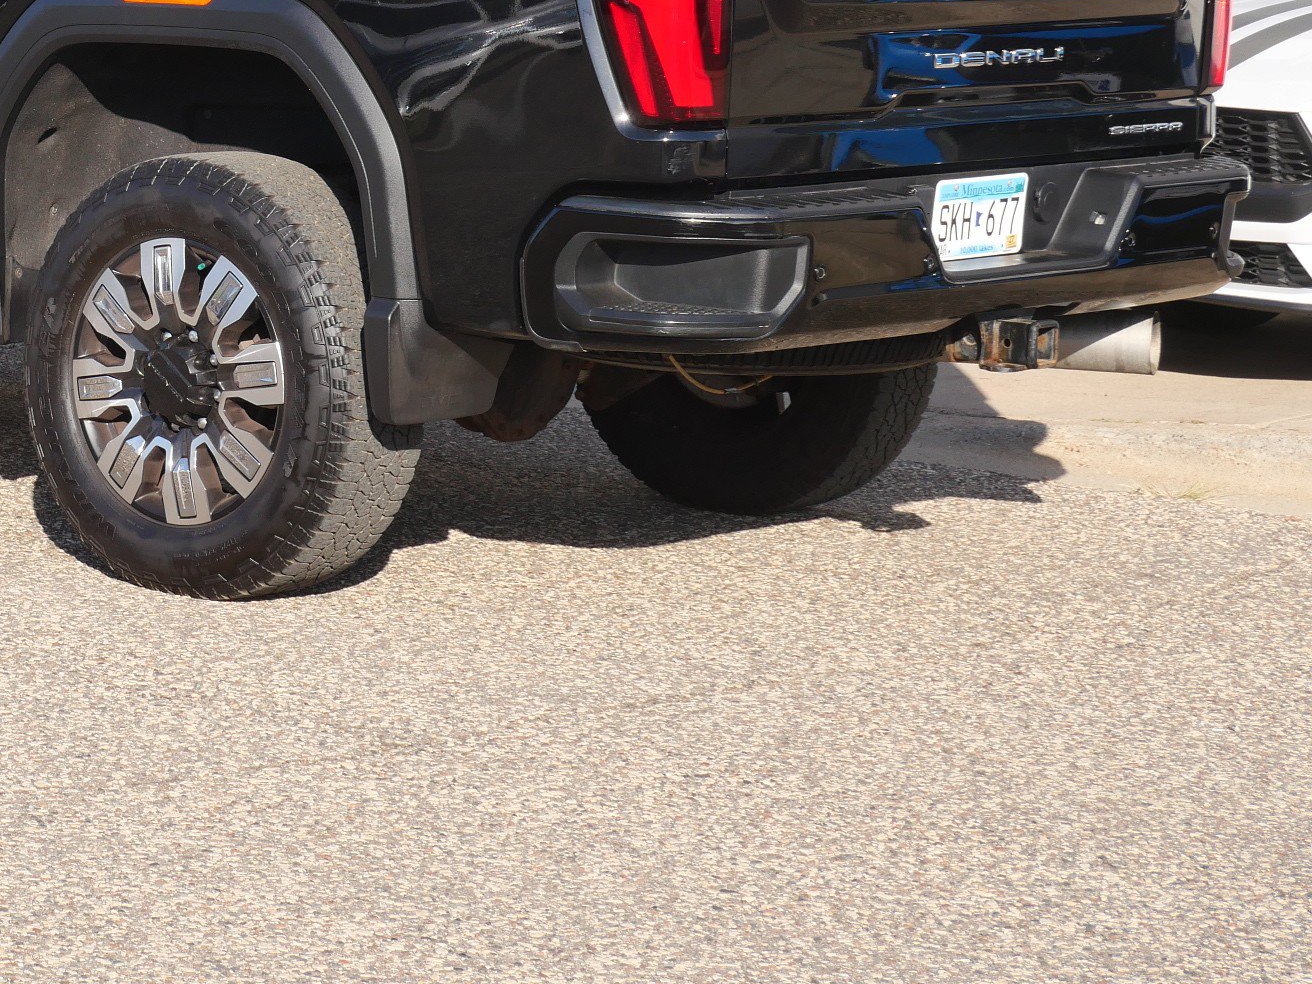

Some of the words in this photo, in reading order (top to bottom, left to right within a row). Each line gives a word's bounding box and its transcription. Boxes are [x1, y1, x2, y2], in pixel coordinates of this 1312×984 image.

[933, 46, 1064, 69] DENALI
[1109, 122, 1183, 135] SIERRA
[960, 184, 1003, 196] Minnesota
[938, 202, 973, 243] SKH
[986, 197, 1019, 236] 677
